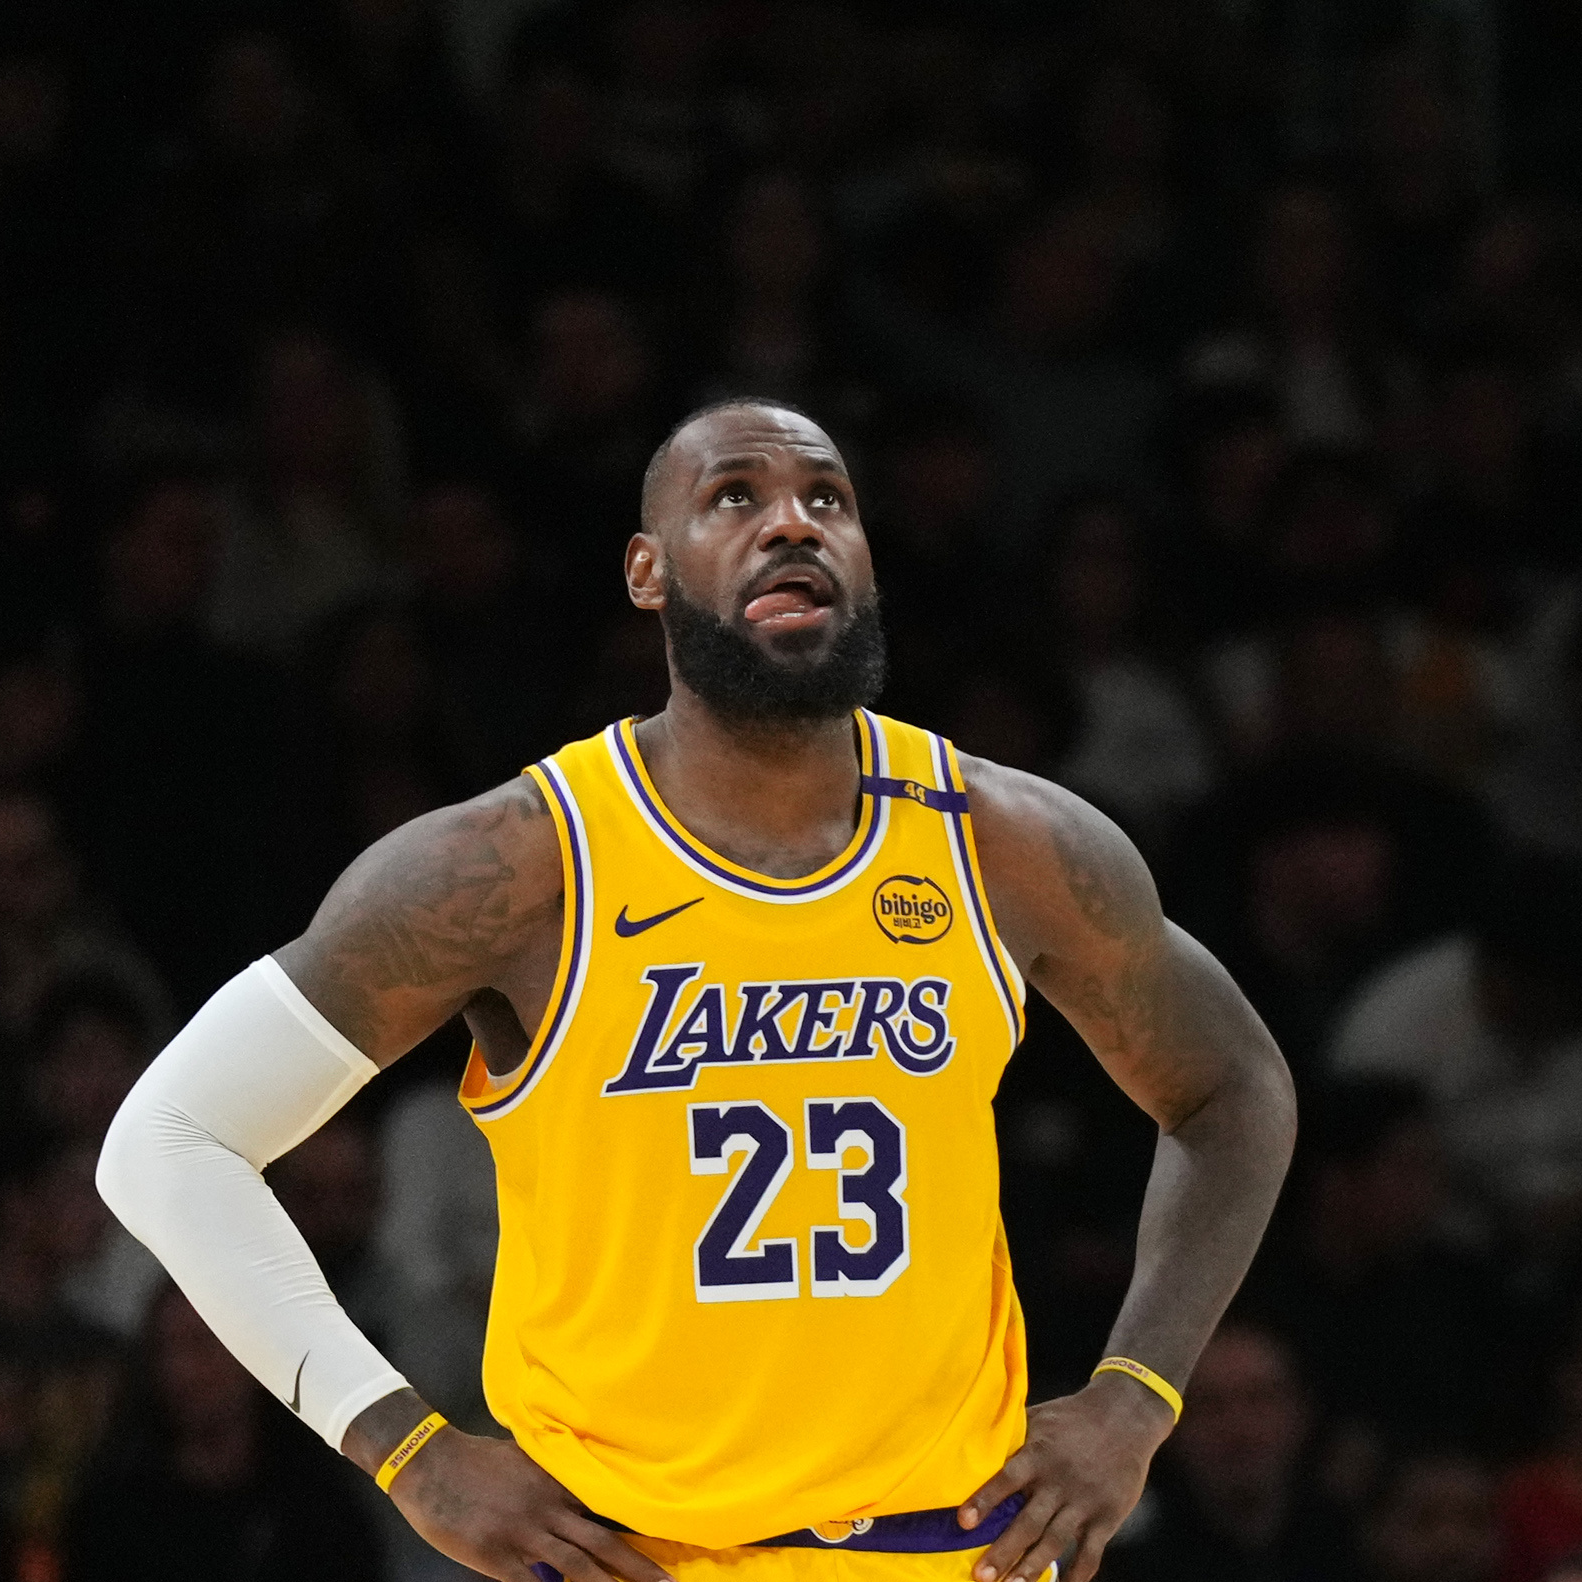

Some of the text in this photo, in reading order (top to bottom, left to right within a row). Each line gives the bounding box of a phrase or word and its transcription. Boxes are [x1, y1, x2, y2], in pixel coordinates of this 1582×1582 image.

[879, 892, 947, 925] bibigo
[601, 962, 957, 1097] LAKERS
[687, 1097, 912, 1303] 23
[387, 1421, 435, 1470] I PROMISE
